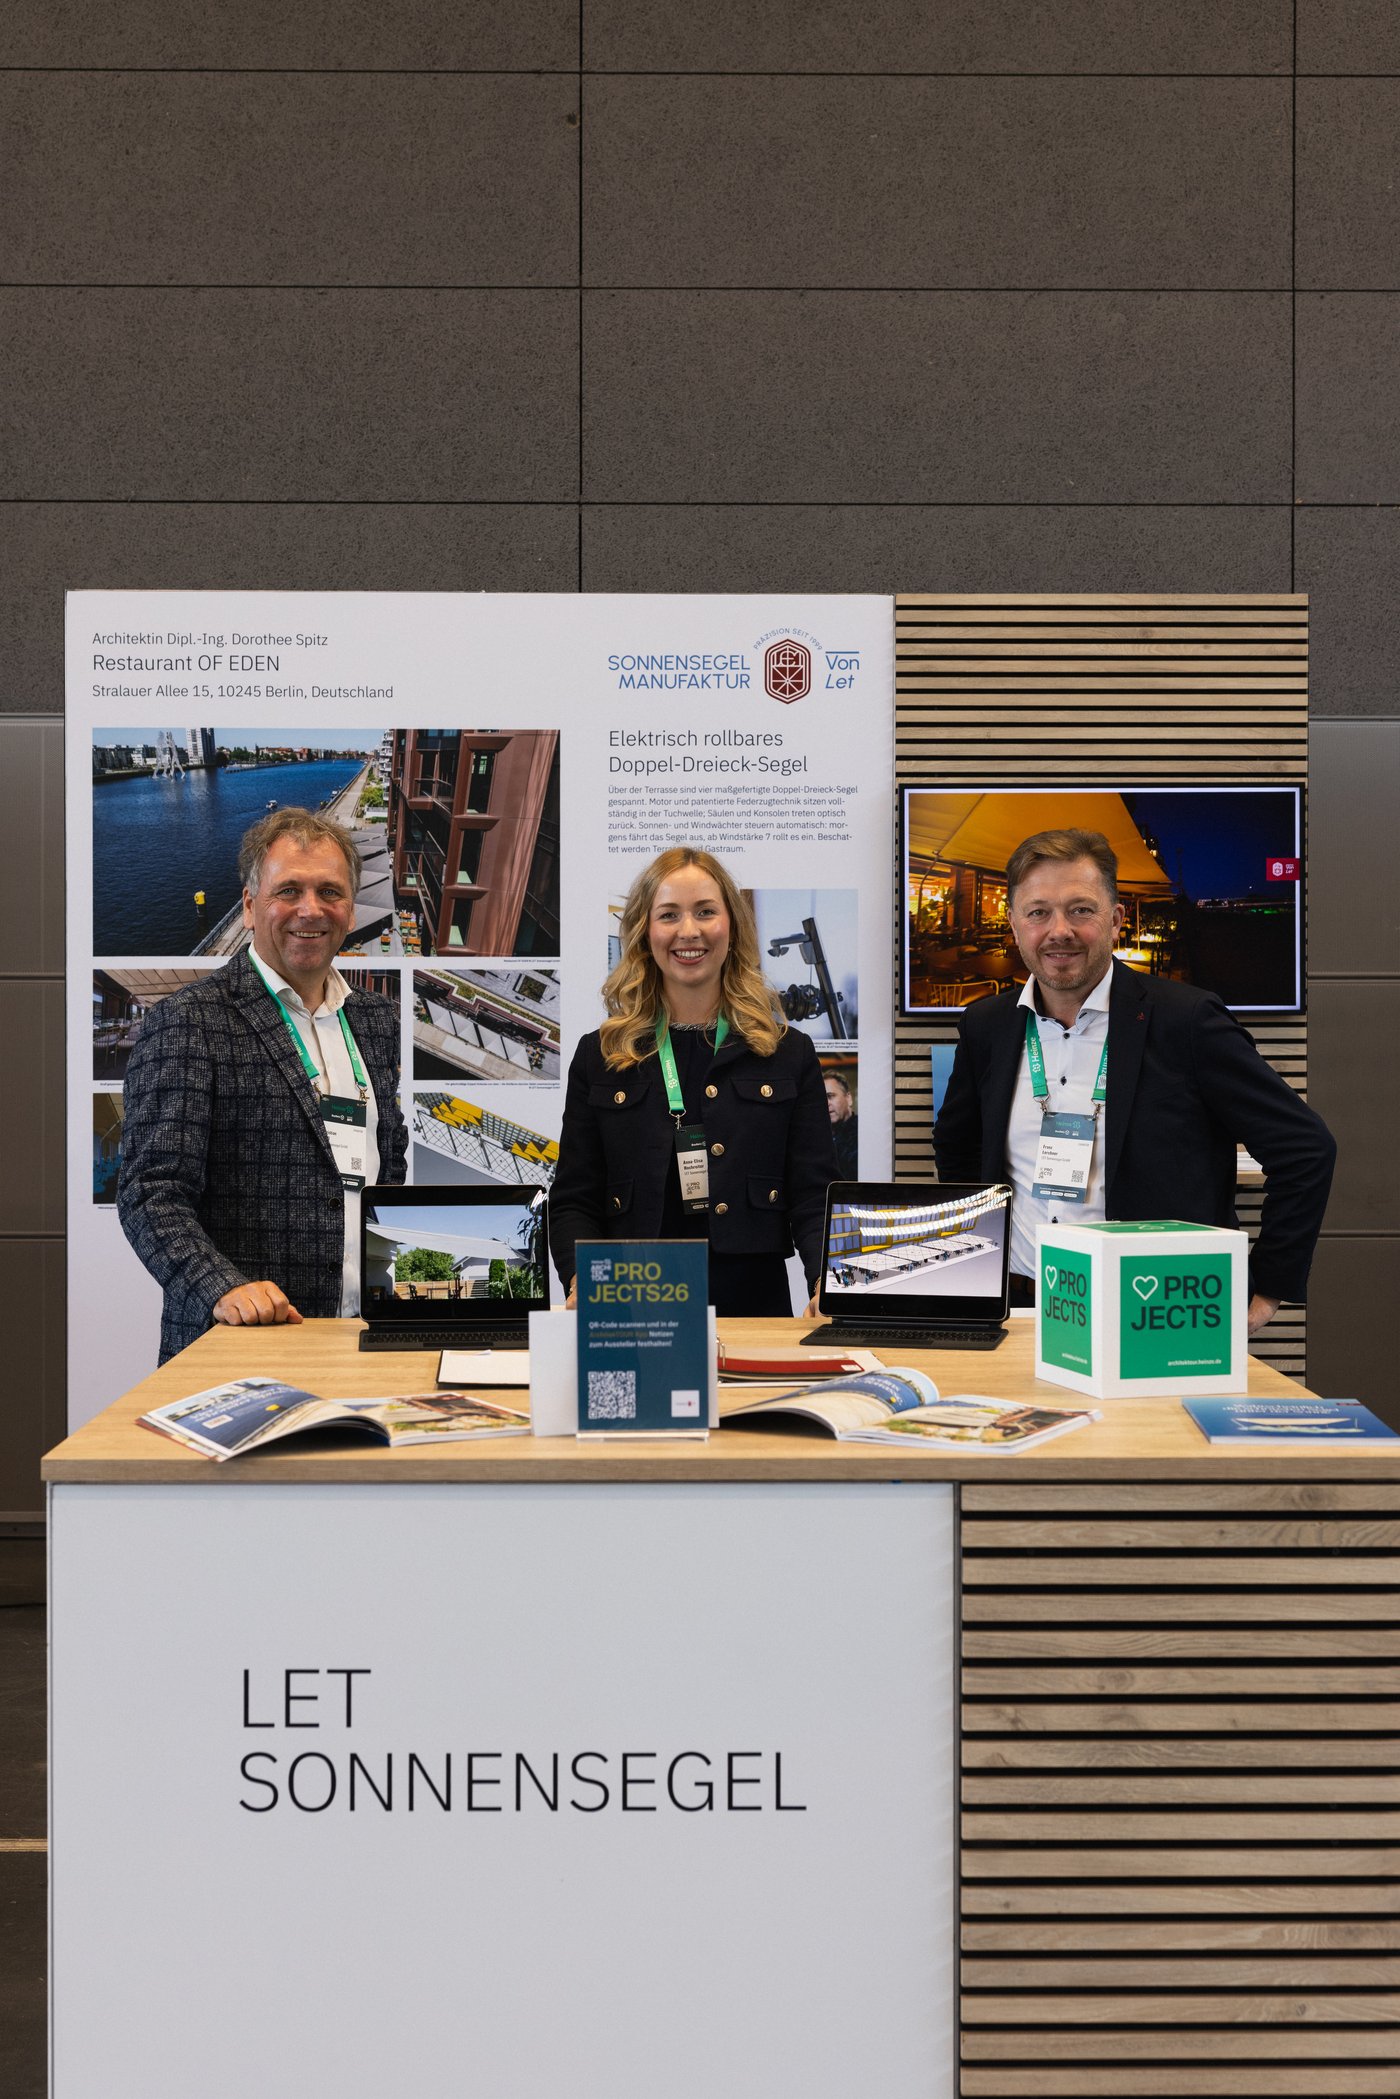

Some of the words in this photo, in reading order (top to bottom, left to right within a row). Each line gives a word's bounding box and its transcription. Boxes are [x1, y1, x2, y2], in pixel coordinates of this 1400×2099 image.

[93, 632, 162, 644] Architektin
[168, 633, 227, 648] Dipl.-Ing.
[232, 633, 292, 645] Dorothee
[296, 634, 327, 648] Spitz
[792, 627, 809, 639] SEIT
[809, 635, 823, 651] 1999
[94, 655, 192, 670] Restaurant
[198, 655, 222, 671] OF
[230, 655, 279, 671] EDEN
[608, 655, 750, 670] SONNENSEGEL
[826, 655, 859, 670] Von
[619, 674, 750, 689] MANUFAKTUR
[825, 674, 854, 689] Let
[93, 685, 152, 696] Stralauer
[156, 685, 188, 697] Allee
[193, 685, 213, 698] 15,
[218, 685, 261, 697] 10245
[266, 686, 307, 699] Berlin,
[312, 686, 393, 698] Deutschland
[610, 730, 697, 746] Elektrisch
[705, 730, 783, 746] rollbares
[610, 756, 807, 776] Doppel-Dreieck-Segel
[609, 784, 627, 793] Über
[715, 785, 770, 795] maßgefertigte
[773, 785, 858, 795] Doppel-Dreieck-Segel
[608, 799, 647, 807] gespannt.
[691, 798, 735, 806] patentierte
[737, 797, 801, 807] Federzugtechnik
[803, 797, 826, 805] sitzen
[828, 797, 845, 805] voll-
[608, 810, 637, 819] ständig
[664, 809, 705, 818] Tuchwelle;
[708, 809, 734, 817] Säulen
[737, 809, 751, 817] und
[817, 809, 846, 818] optisch
[691, 821, 742, 829] Windwächter
[776, 821, 827, 829] automatisch:
[629, 833, 647, 841] fährt
[650, 833, 664, 841] das
[666, 833, 687, 842] Segel
[608, 845, 618, 853] tet
[621, 845, 650, 853] werden
[705, 845, 746, 853] Gastraum.
[1031, 1037, 1039, 1062] Heinze
[614, 1262, 661, 1281] PRO
[1058, 1269, 1087, 1298] PRO
[1164, 1274, 1223, 1300] PRO
[588, 1283, 689, 1303] JECTS26
[1045, 1295, 1087, 1327] JECTS
[1131, 1304, 1221, 1331] JECTS
[588, 1321, 617, 1329] QR-Code
[244, 1669, 371, 1728] LET
[240, 1751, 807, 1812] SONNENSEGEL
